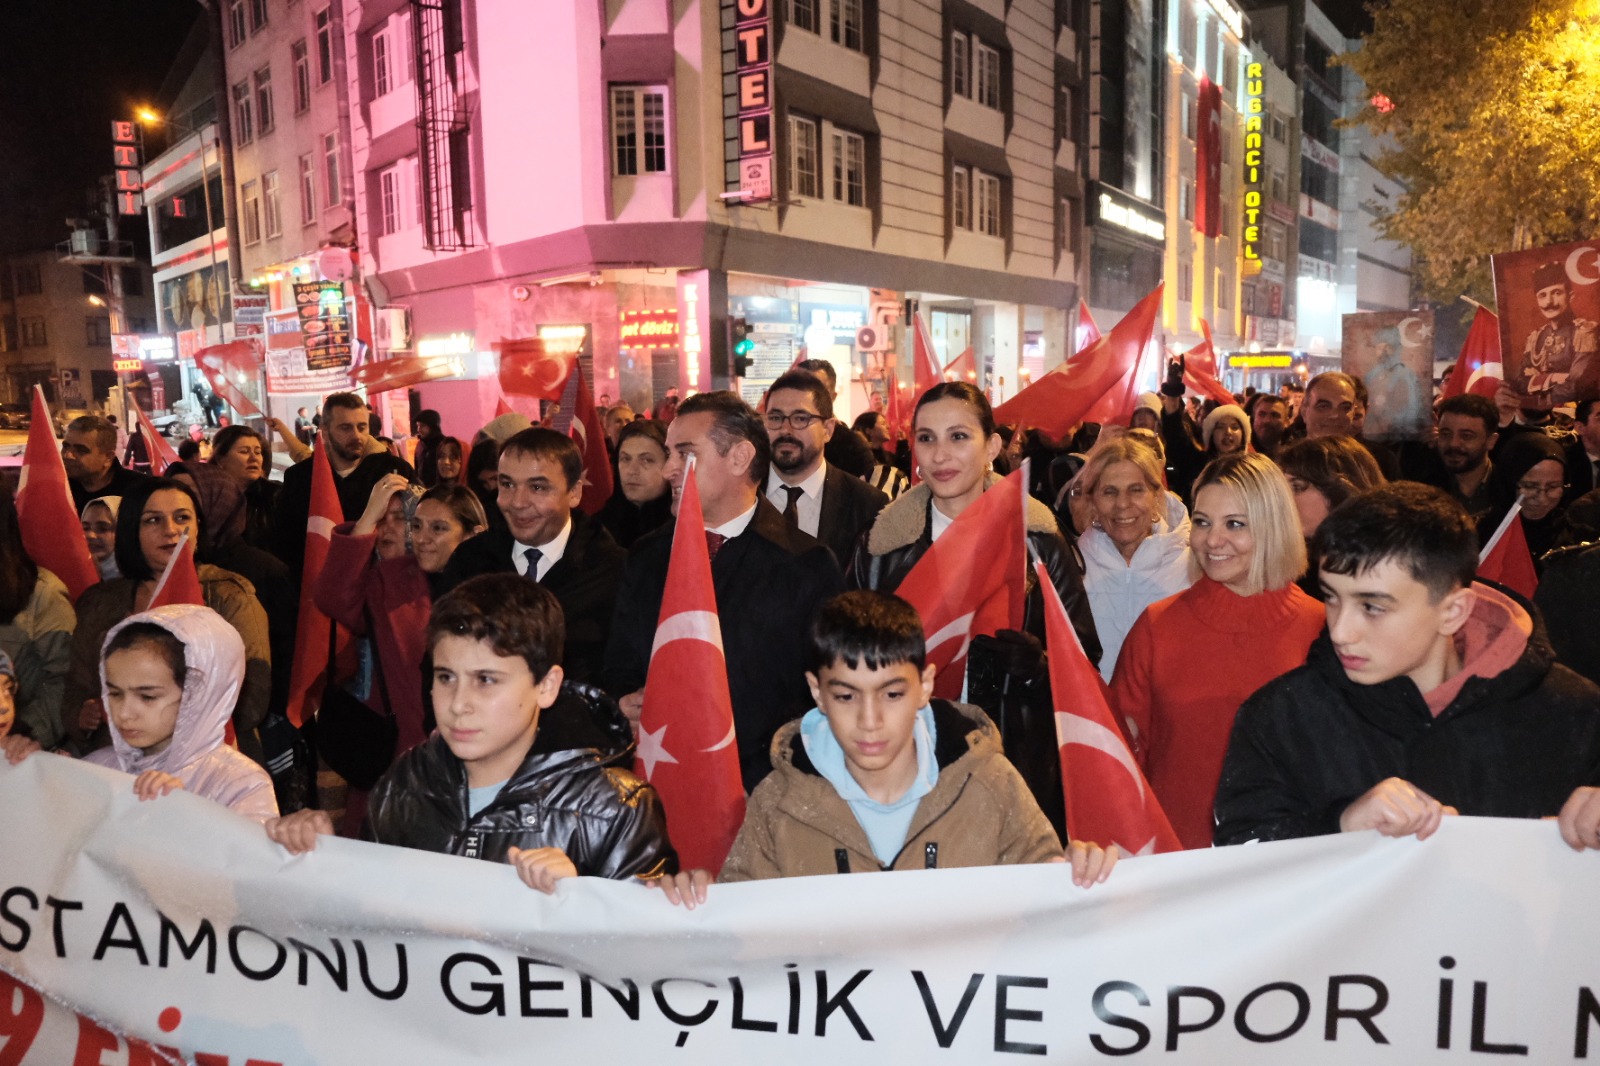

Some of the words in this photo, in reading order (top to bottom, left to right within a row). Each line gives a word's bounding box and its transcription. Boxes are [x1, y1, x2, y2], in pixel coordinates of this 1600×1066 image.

[114, 121, 138, 214] ETLİ
[1245, 63, 1262, 183] RUGANCI
[1245, 191, 1260, 259] OTEL
[640, 320, 674, 335] döviz
[0, 887, 408, 1000] STAMONU
[440, 952, 875, 1048] GENÇLİK
[910, 970, 1048, 1056] VE
[1089, 973, 1391, 1057] SPOR
[1435, 956, 1529, 1057] İL
